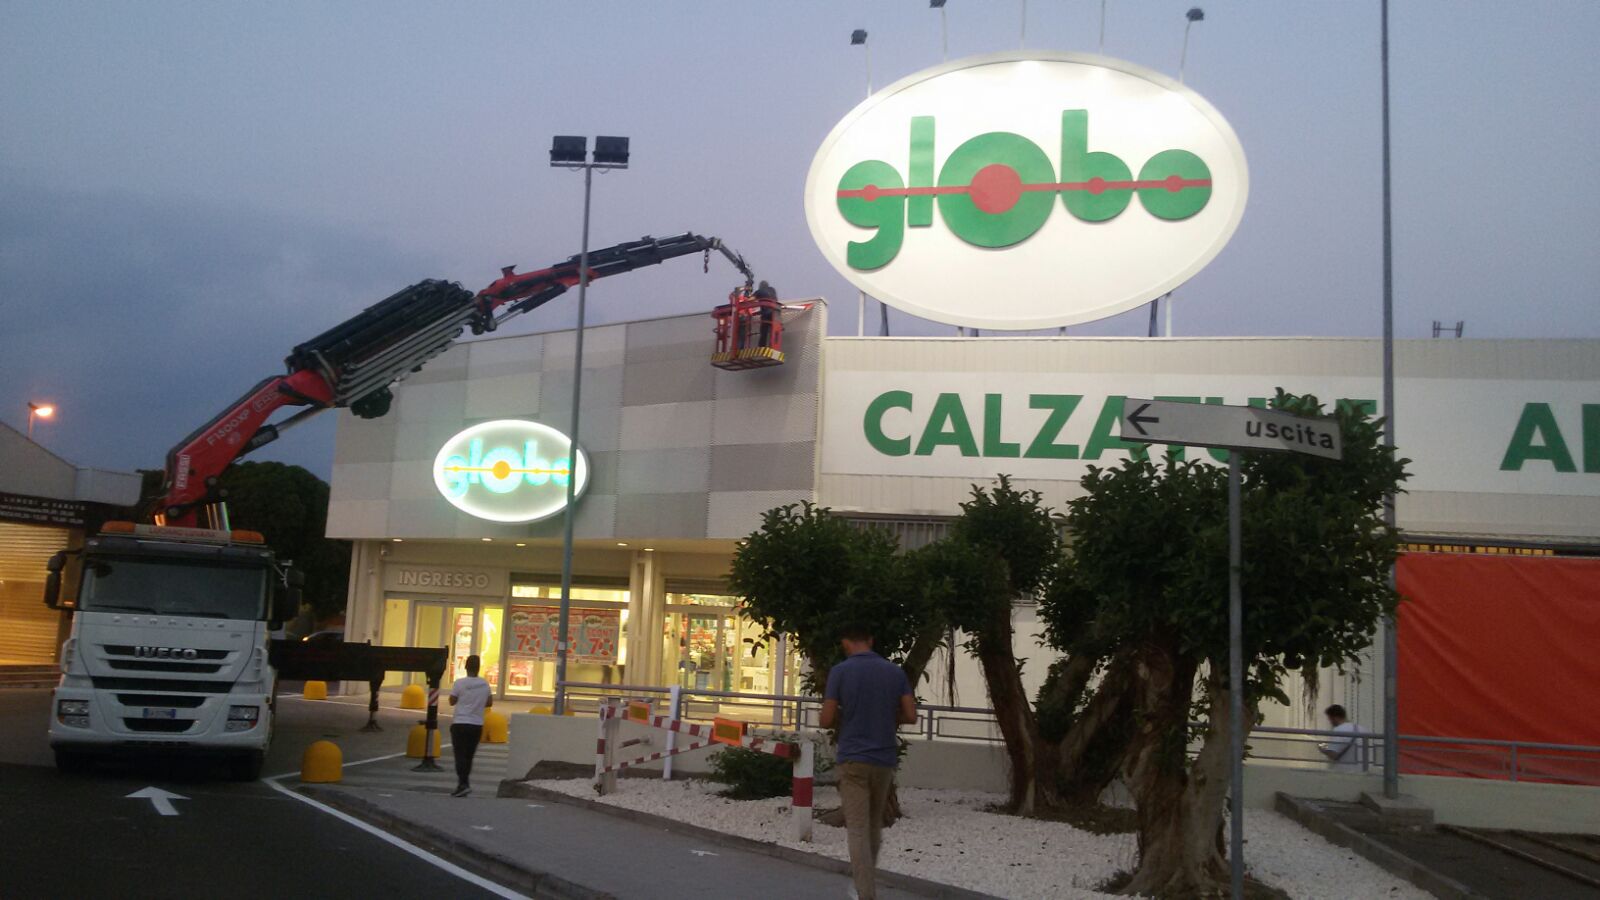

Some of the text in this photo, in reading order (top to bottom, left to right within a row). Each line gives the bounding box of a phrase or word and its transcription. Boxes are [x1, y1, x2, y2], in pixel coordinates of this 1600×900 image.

[837, 109, 1212, 270] globo
[863, 390, 1377, 461] CALZA
[1246, 419, 1335, 450] uscita
[399, 570, 489, 588] INGRESSO
[134, 646, 198, 660] IVECO
